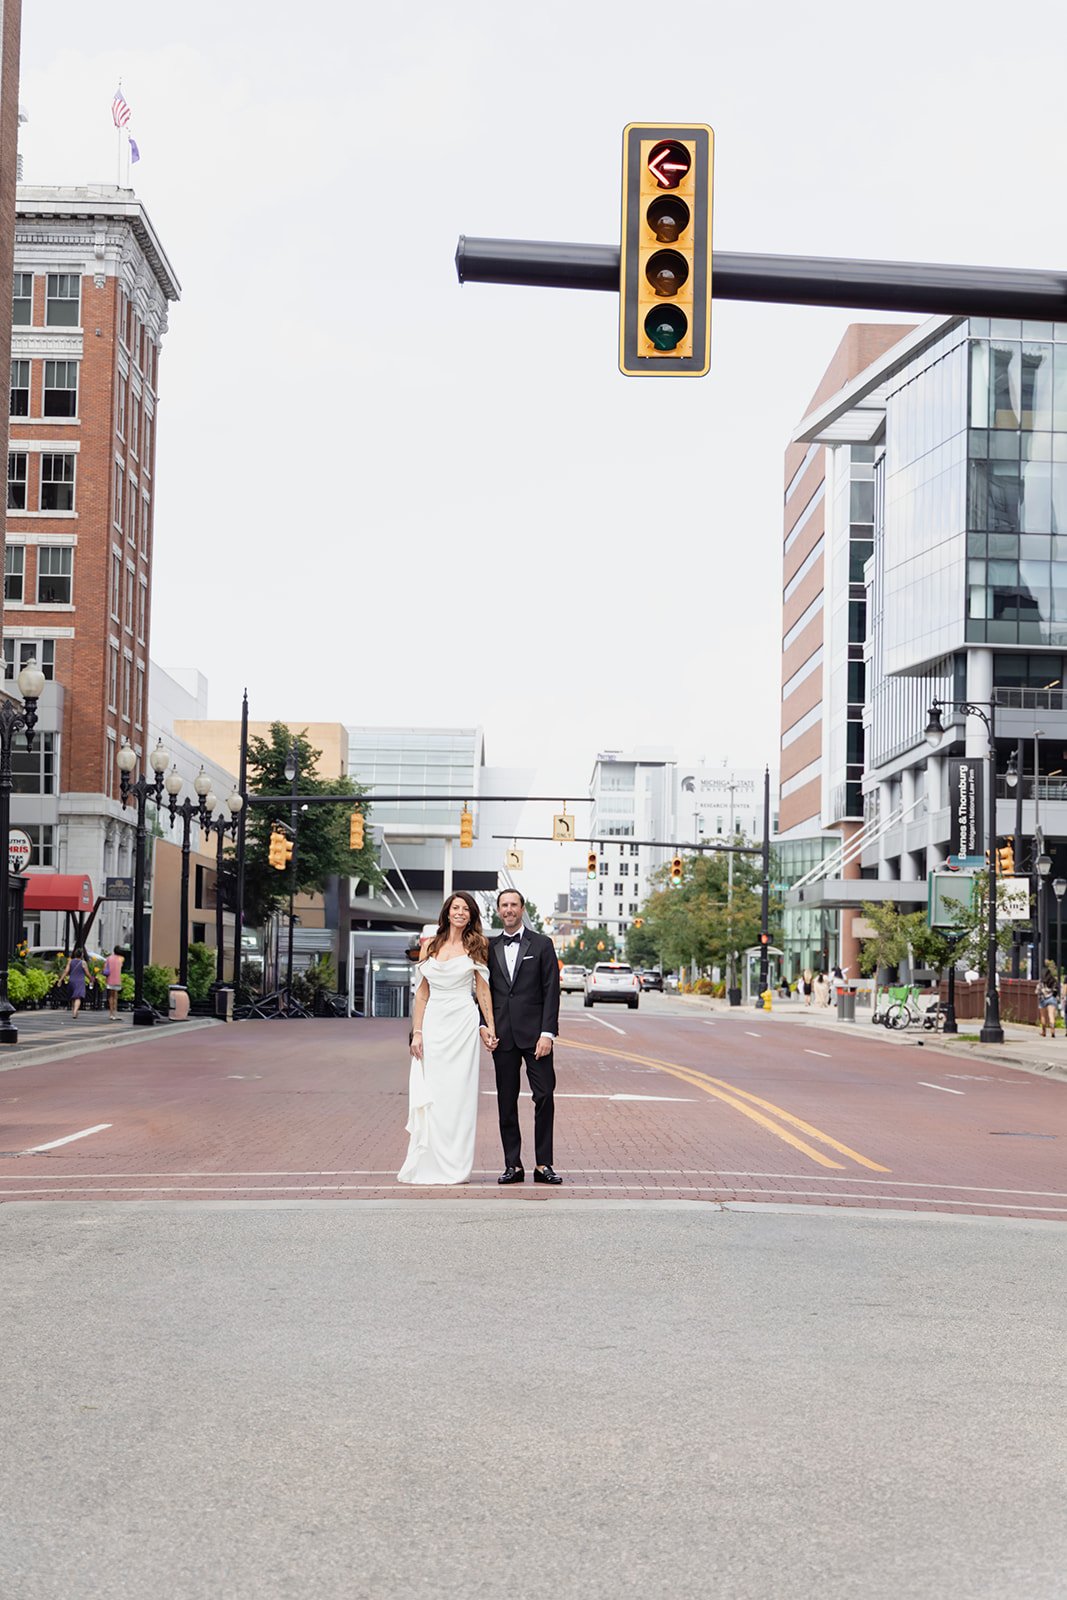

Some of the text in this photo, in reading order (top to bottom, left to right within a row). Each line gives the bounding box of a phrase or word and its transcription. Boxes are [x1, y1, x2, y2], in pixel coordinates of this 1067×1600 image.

[958, 765, 968, 860] Barnes & Thornburg
